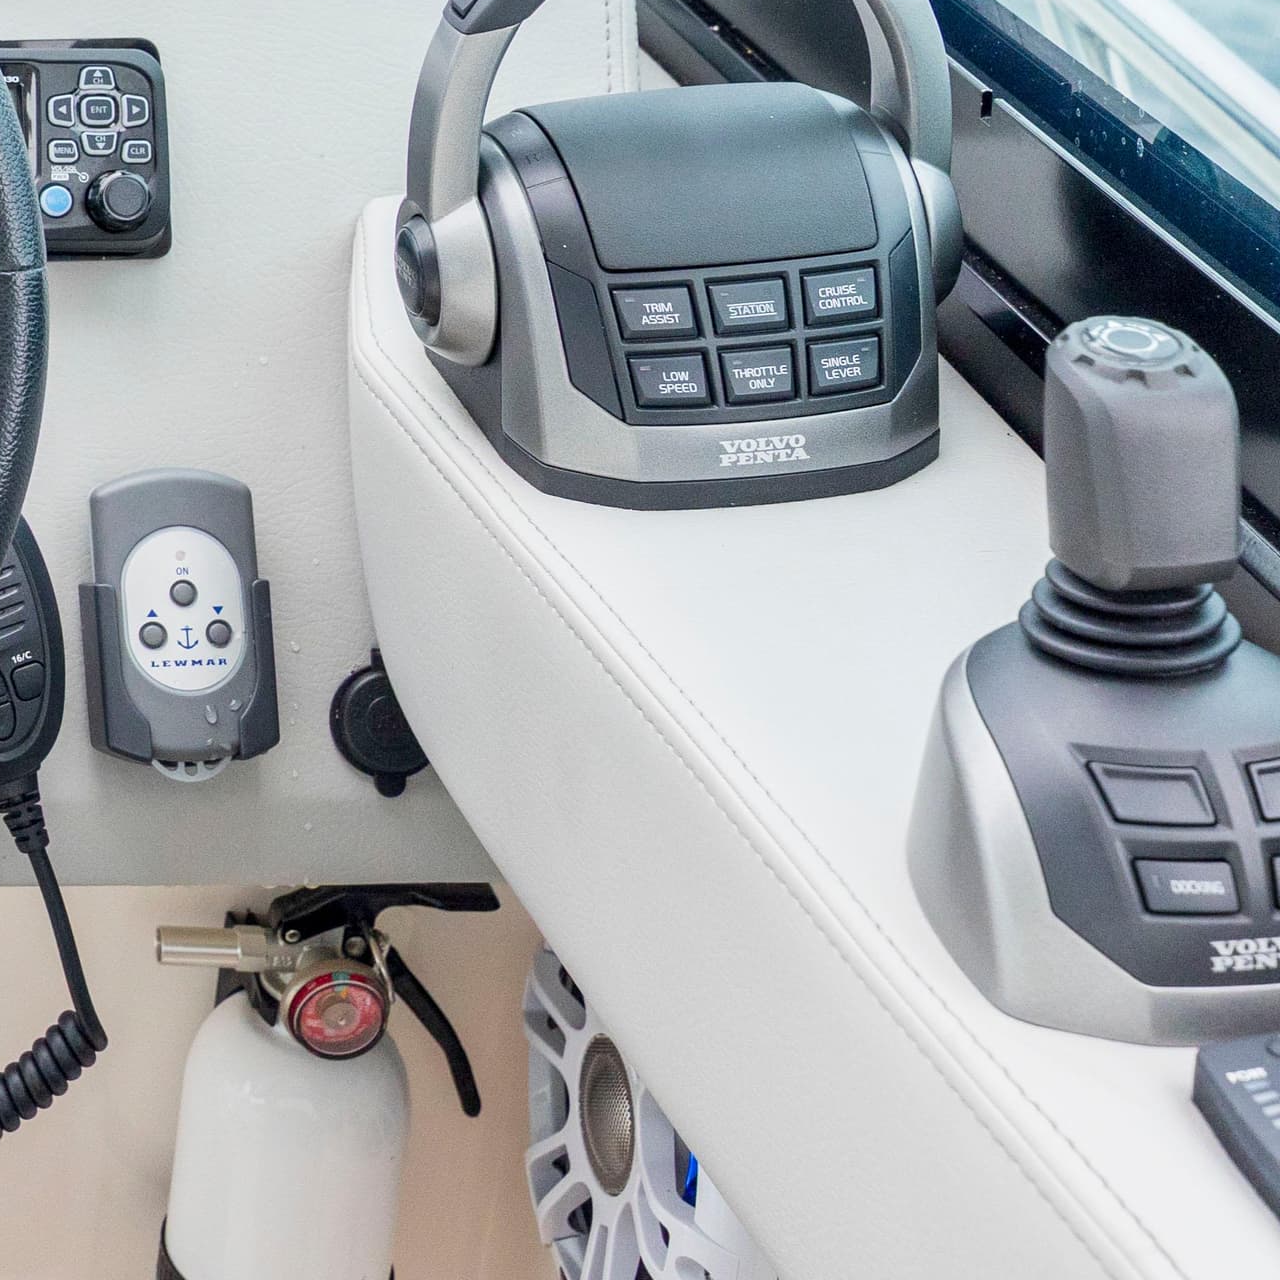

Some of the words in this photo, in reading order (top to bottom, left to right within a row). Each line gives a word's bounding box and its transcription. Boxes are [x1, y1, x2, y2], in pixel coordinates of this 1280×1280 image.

[90, 105, 108, 114] ENT
[54, 146, 75, 154] MENU
[130, 147, 146, 155] CLR
[818, 284, 857, 298] CRUISE
[642, 302, 674, 313] TRIM
[819, 295, 868, 310] CONTROL
[728, 303, 775, 316] STATION
[642, 313, 680, 325] ASSIST
[820, 354, 861, 369] SINGLE
[662, 371, 689, 382] LOW
[732, 364, 788, 379] THROTTLE
[825, 366, 862, 380] LEVER
[658, 383, 698, 394] SPEED
[749, 378, 776, 390] ONLY
[719, 434, 806, 453] VOLVO
[719, 447, 811, 467] PENTA
[175, 567, 189, 575] ON
[11, 650, 33, 664] 16/C
[151, 658, 228, 667] LEWMAR
